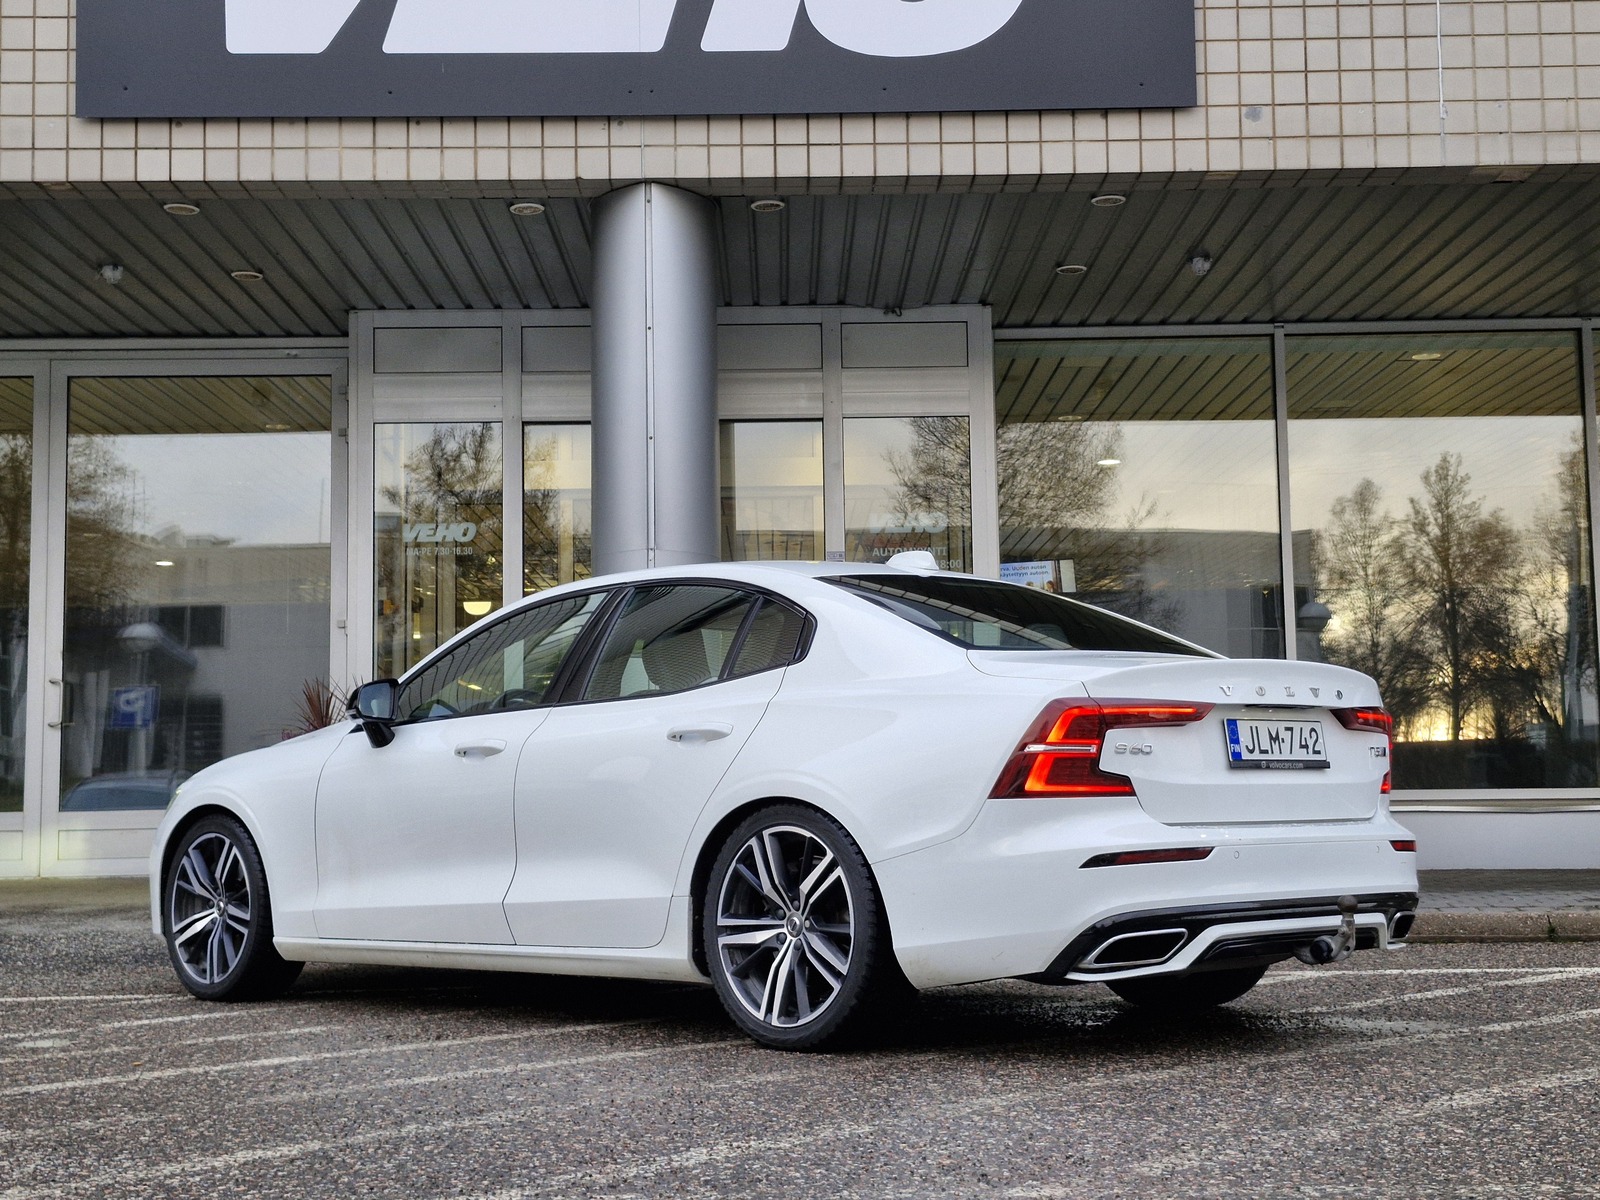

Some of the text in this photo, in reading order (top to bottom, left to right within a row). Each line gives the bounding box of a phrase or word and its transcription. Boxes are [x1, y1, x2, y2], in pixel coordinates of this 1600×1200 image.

[402, 522, 477, 542] VEHO
[406, 546, 473, 555] MA-PE 7.30-16.30
[1219, 685, 1344, 700] VOLVO
[1245, 725, 1321, 755] JLM-742
[1114, 742, 1154, 755] S60
[1231, 743, 1241, 753] FIN
[1269, 761, 1304, 769] volvocars.com
